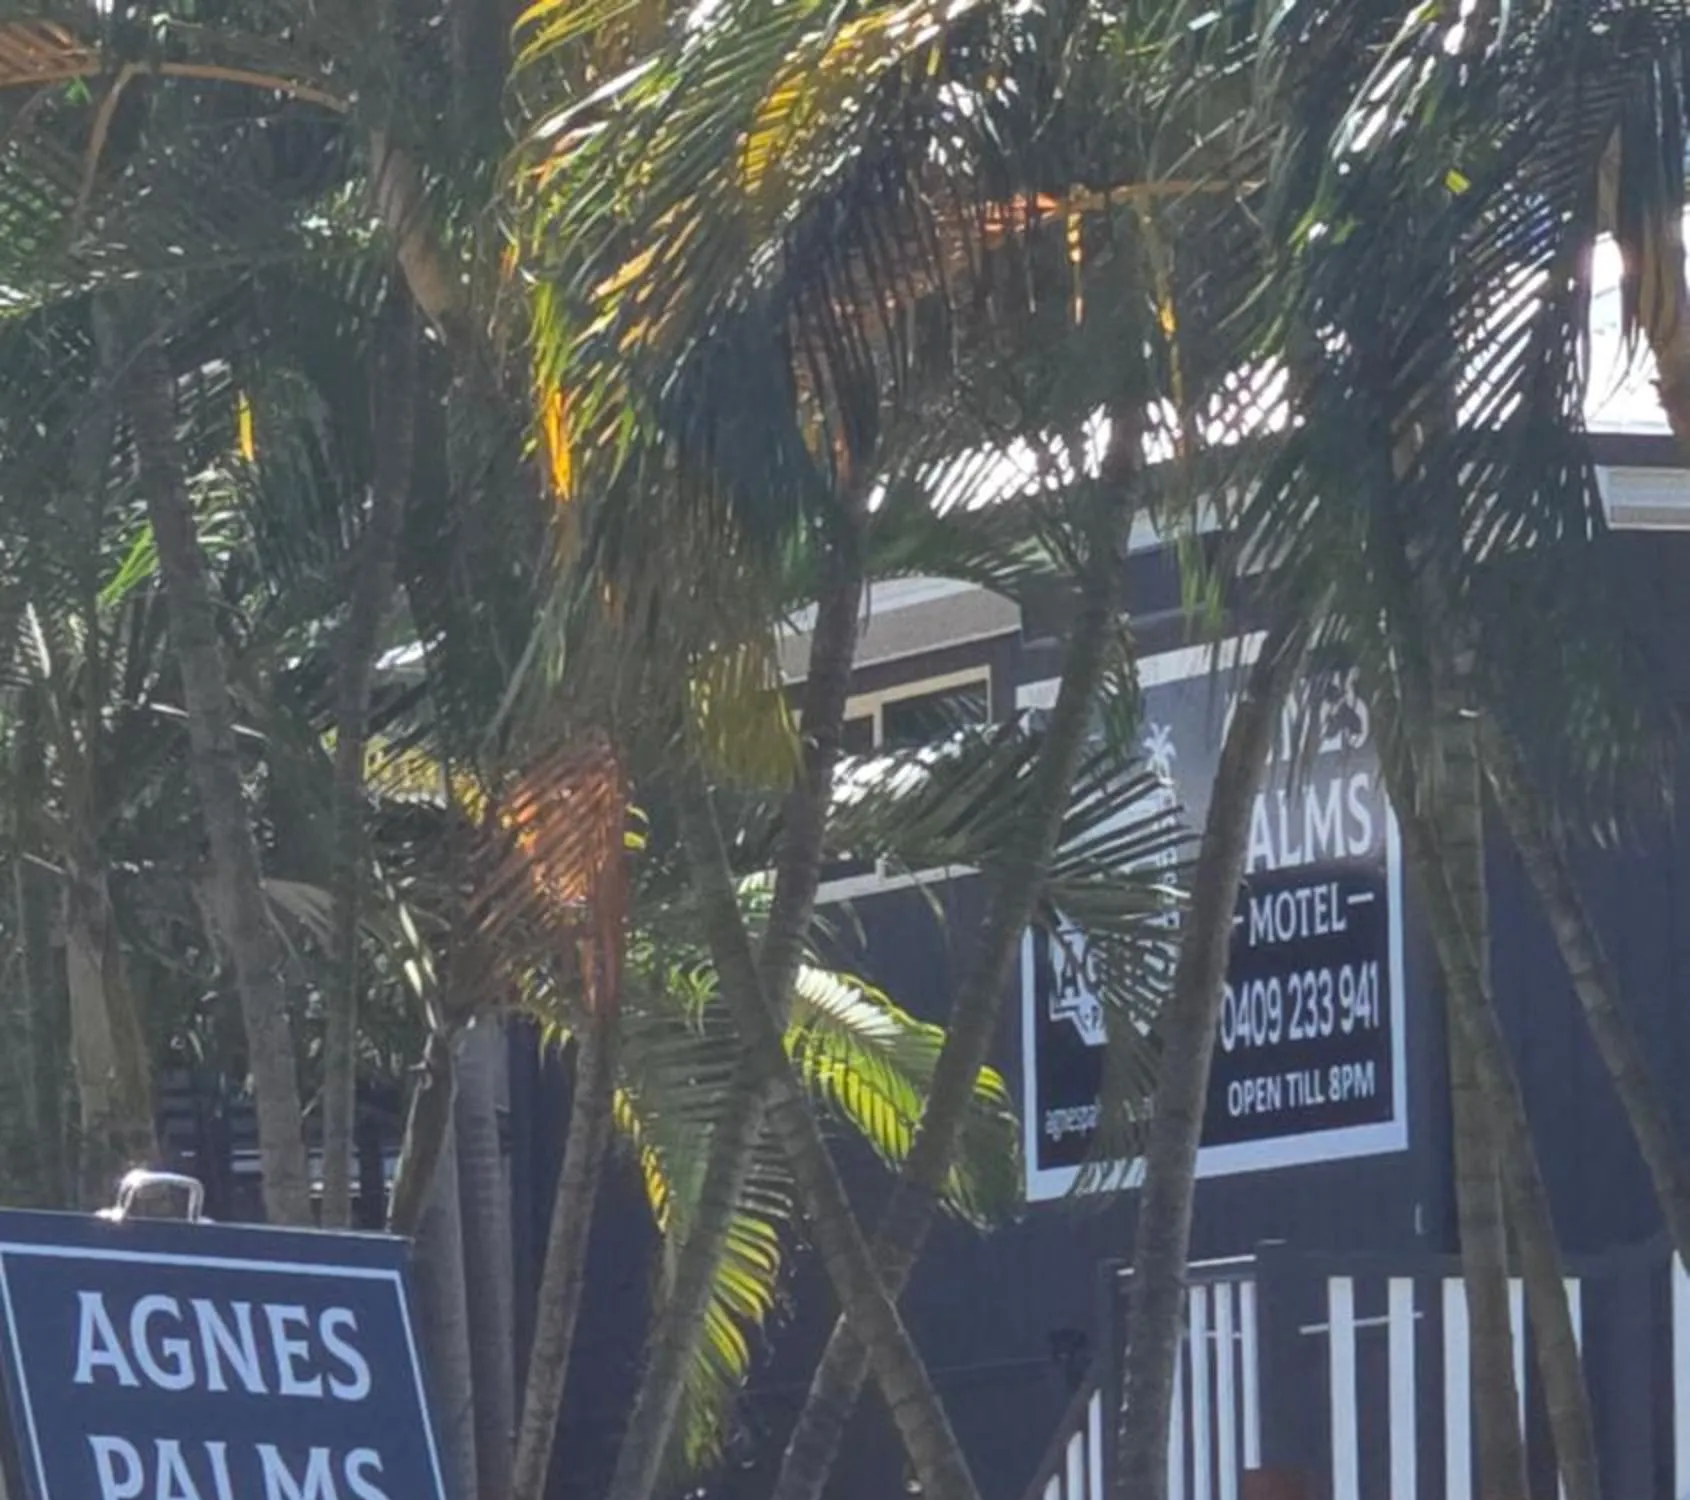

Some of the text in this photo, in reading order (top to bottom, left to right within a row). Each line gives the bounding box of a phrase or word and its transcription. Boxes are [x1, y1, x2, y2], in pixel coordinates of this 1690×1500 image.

[1245, 773, 1372, 874] ALMS
[1249, 882, 1347, 947] MOTEL
[1220, 960, 1379, 1053] 0409 233 941
[1228, 1059, 1376, 1118] OPEN TILL 8PM
[73, 1290, 372, 1400] AGNES
